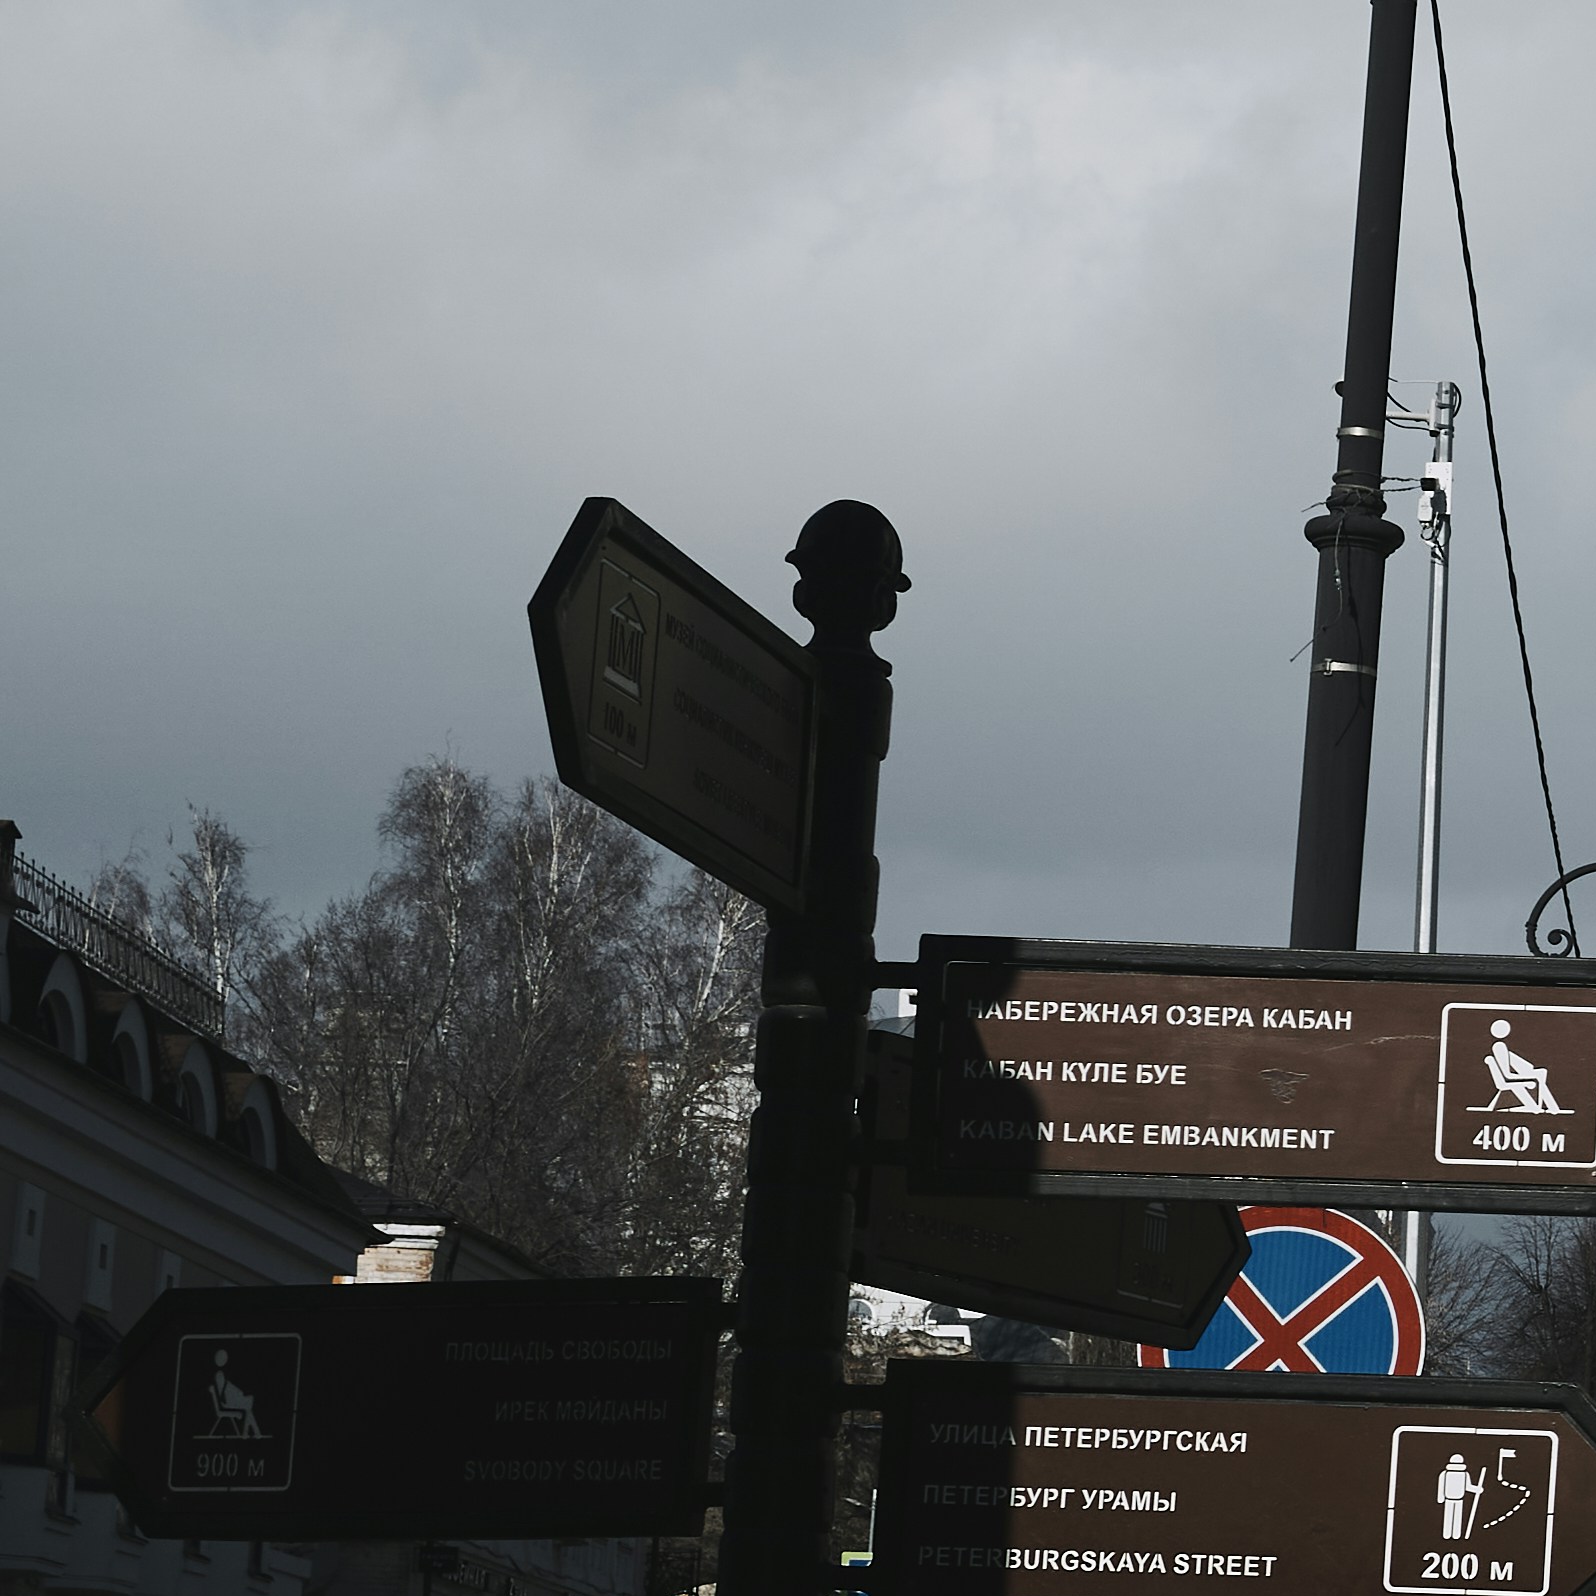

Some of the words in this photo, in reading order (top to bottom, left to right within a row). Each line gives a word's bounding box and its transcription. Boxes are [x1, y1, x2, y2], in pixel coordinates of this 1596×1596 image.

[605, 703, 623, 740] 100
[967, 999, 1158, 1027] НАБЕРЕЖНАЯ
[1166, 1005, 1257, 1029] ОЗЕРА
[1262, 1007, 1352, 1032] КАБАН
[963, 1059, 1053, 1082] КАБАН
[1137, 1063, 1187, 1087] БУЕ
[959, 1120, 1054, 1142] KABAN
[1063, 1122, 1135, 1145] LAKE
[1143, 1124, 1335, 1149] EMBANKMENT
[1473, 1126, 1531, 1153] 400
[445, 1341, 555, 1364] ПЛОЩАДЬ
[562, 1340, 672, 1362] СВОБОДЫ
[495, 1401, 549, 1422] ИРЕК
[929, 1424, 1015, 1448] УЛИЦА
[1024, 1427, 1247, 1454] ПЕТЕРБУРГСКАЯ
[197, 1453, 239, 1478] 900
[464, 1460, 567, 1482] SVOBODY
[573, 1459, 662, 1482] SQUARE
[923, 1484, 1076, 1509] ПЕТЕРБУРГ
[1082, 1488, 1176, 1512] УРАМЫ
[918, 1546, 1167, 1575] PETERBURGSKAYA
[1174, 1553, 1277, 1578] STREET
[1421, 1553, 1478, 1580] 200
